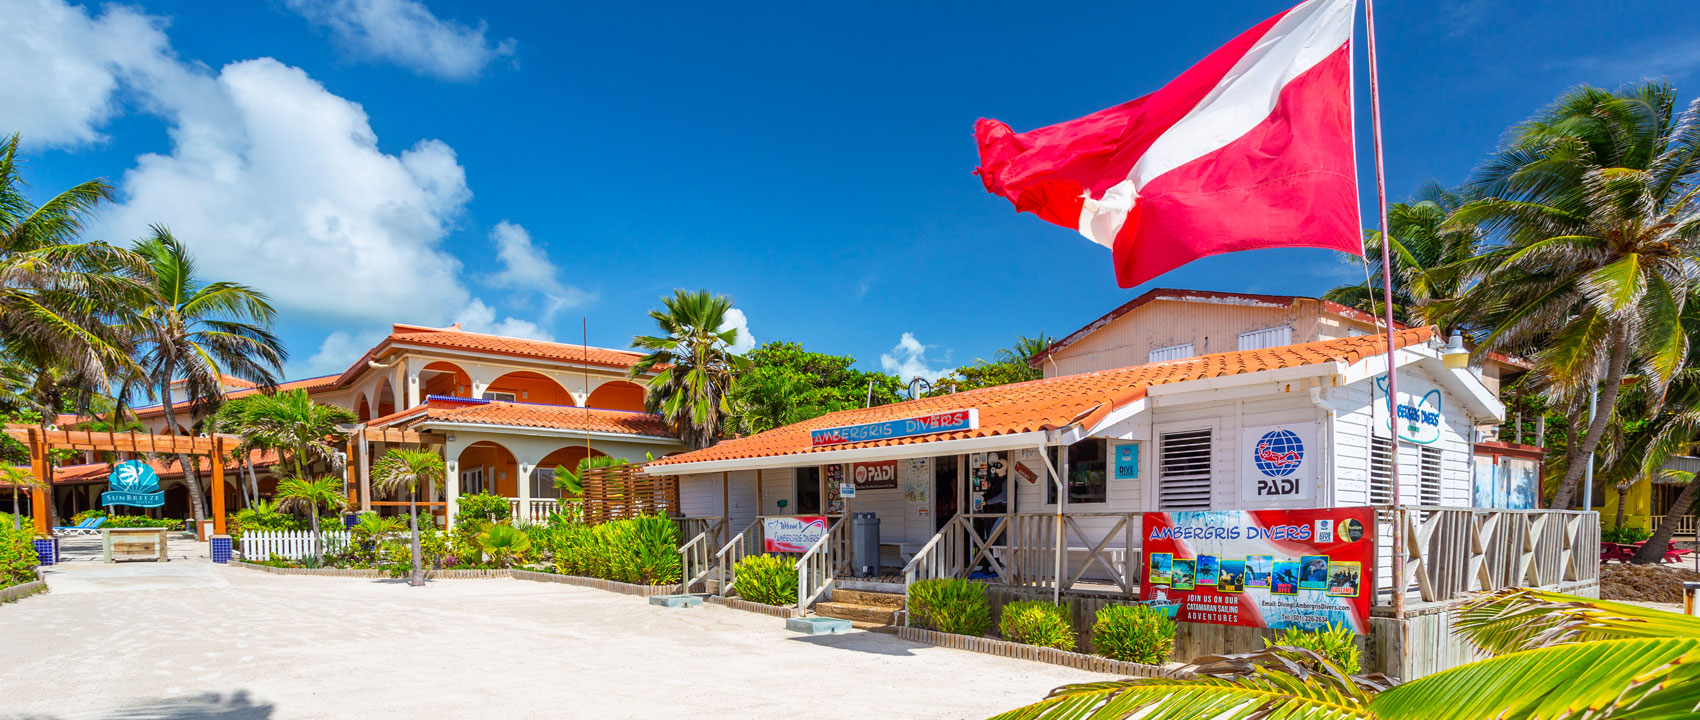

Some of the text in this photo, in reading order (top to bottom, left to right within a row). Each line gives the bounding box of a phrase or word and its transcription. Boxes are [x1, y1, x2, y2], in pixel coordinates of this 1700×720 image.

[1421, 409, 1440, 427] DIVERS
[813, 413, 964, 445] AMBERGRIS DIVERS
[868, 465, 895, 482] PADI
[1257, 478, 1300, 495] PADI
[780, 521, 798, 530] Welcome
[1149, 524, 1311, 541] AMBERGRIS DIVERS
[776, 534, 819, 542] AMBERGRIS DIVERS
[1203, 595, 1212, 603] US
[1225, 596, 1238, 604] OUR
[1187, 603, 1238, 614] CATAMARAN SAILING
[1187, 612, 1238, 623] ADVENTURES
